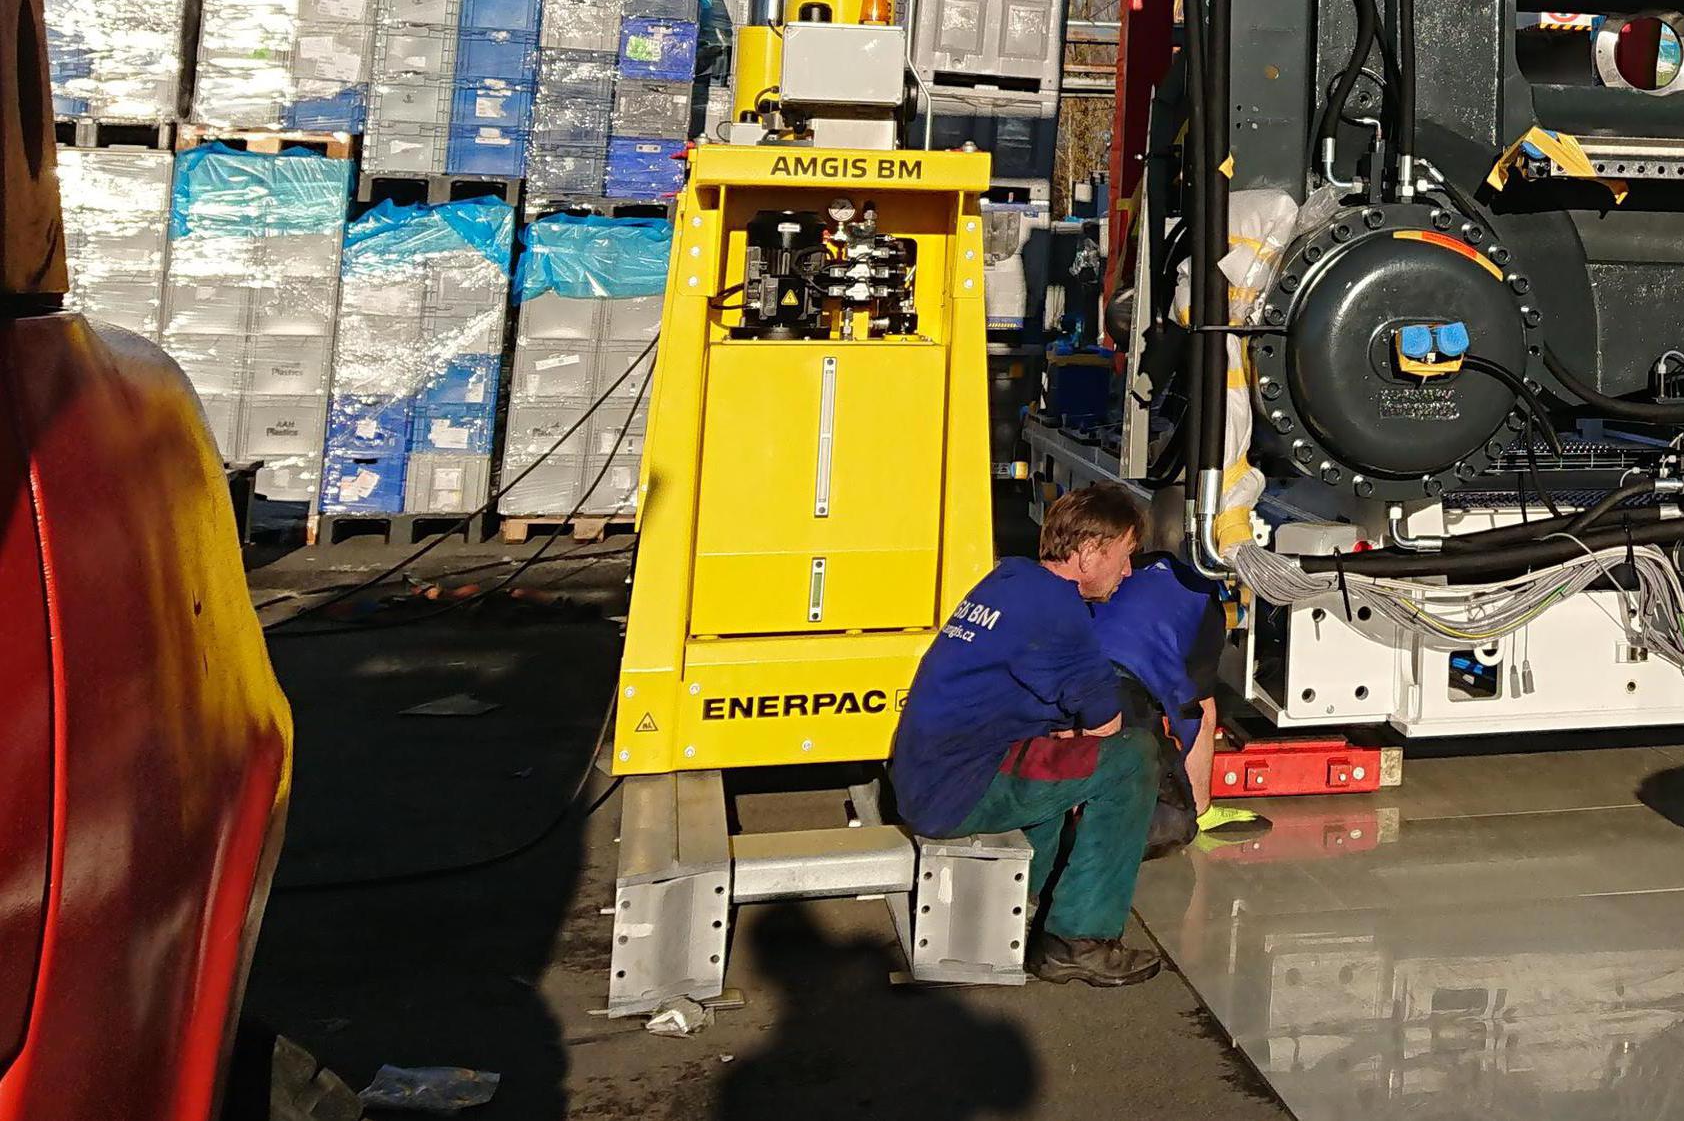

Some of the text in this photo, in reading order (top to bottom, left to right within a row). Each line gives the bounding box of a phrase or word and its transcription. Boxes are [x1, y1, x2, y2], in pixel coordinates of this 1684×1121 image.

[770, 156, 922, 180] AMGIS BM
[967, 604, 1001, 630] BM
[702, 689, 887, 721] ENERPAC
